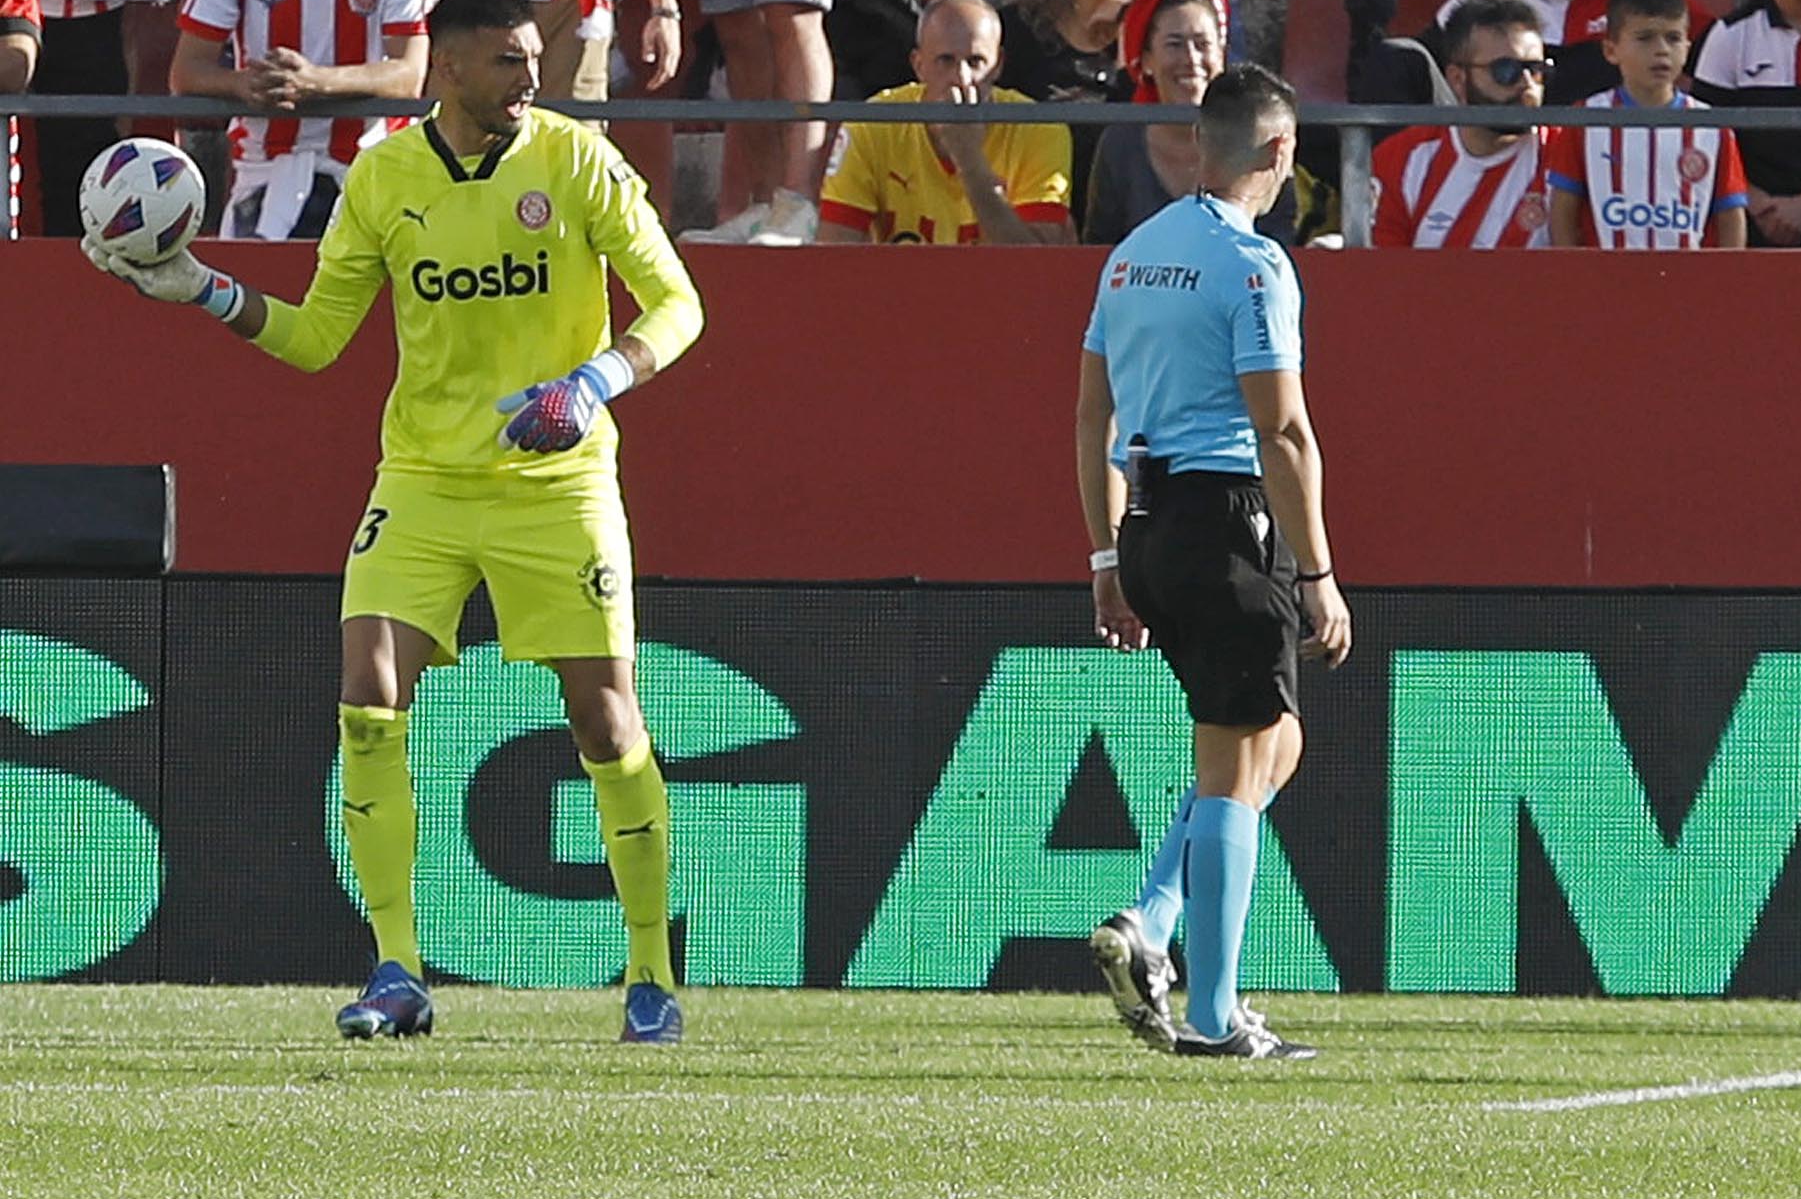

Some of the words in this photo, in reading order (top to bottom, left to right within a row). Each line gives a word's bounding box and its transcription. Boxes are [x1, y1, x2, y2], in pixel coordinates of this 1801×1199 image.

[1602, 197, 1699, 232] Gosbi
[412, 250, 550, 303] Gosbi
[1129, 265, 1201, 291] WÜRTH
